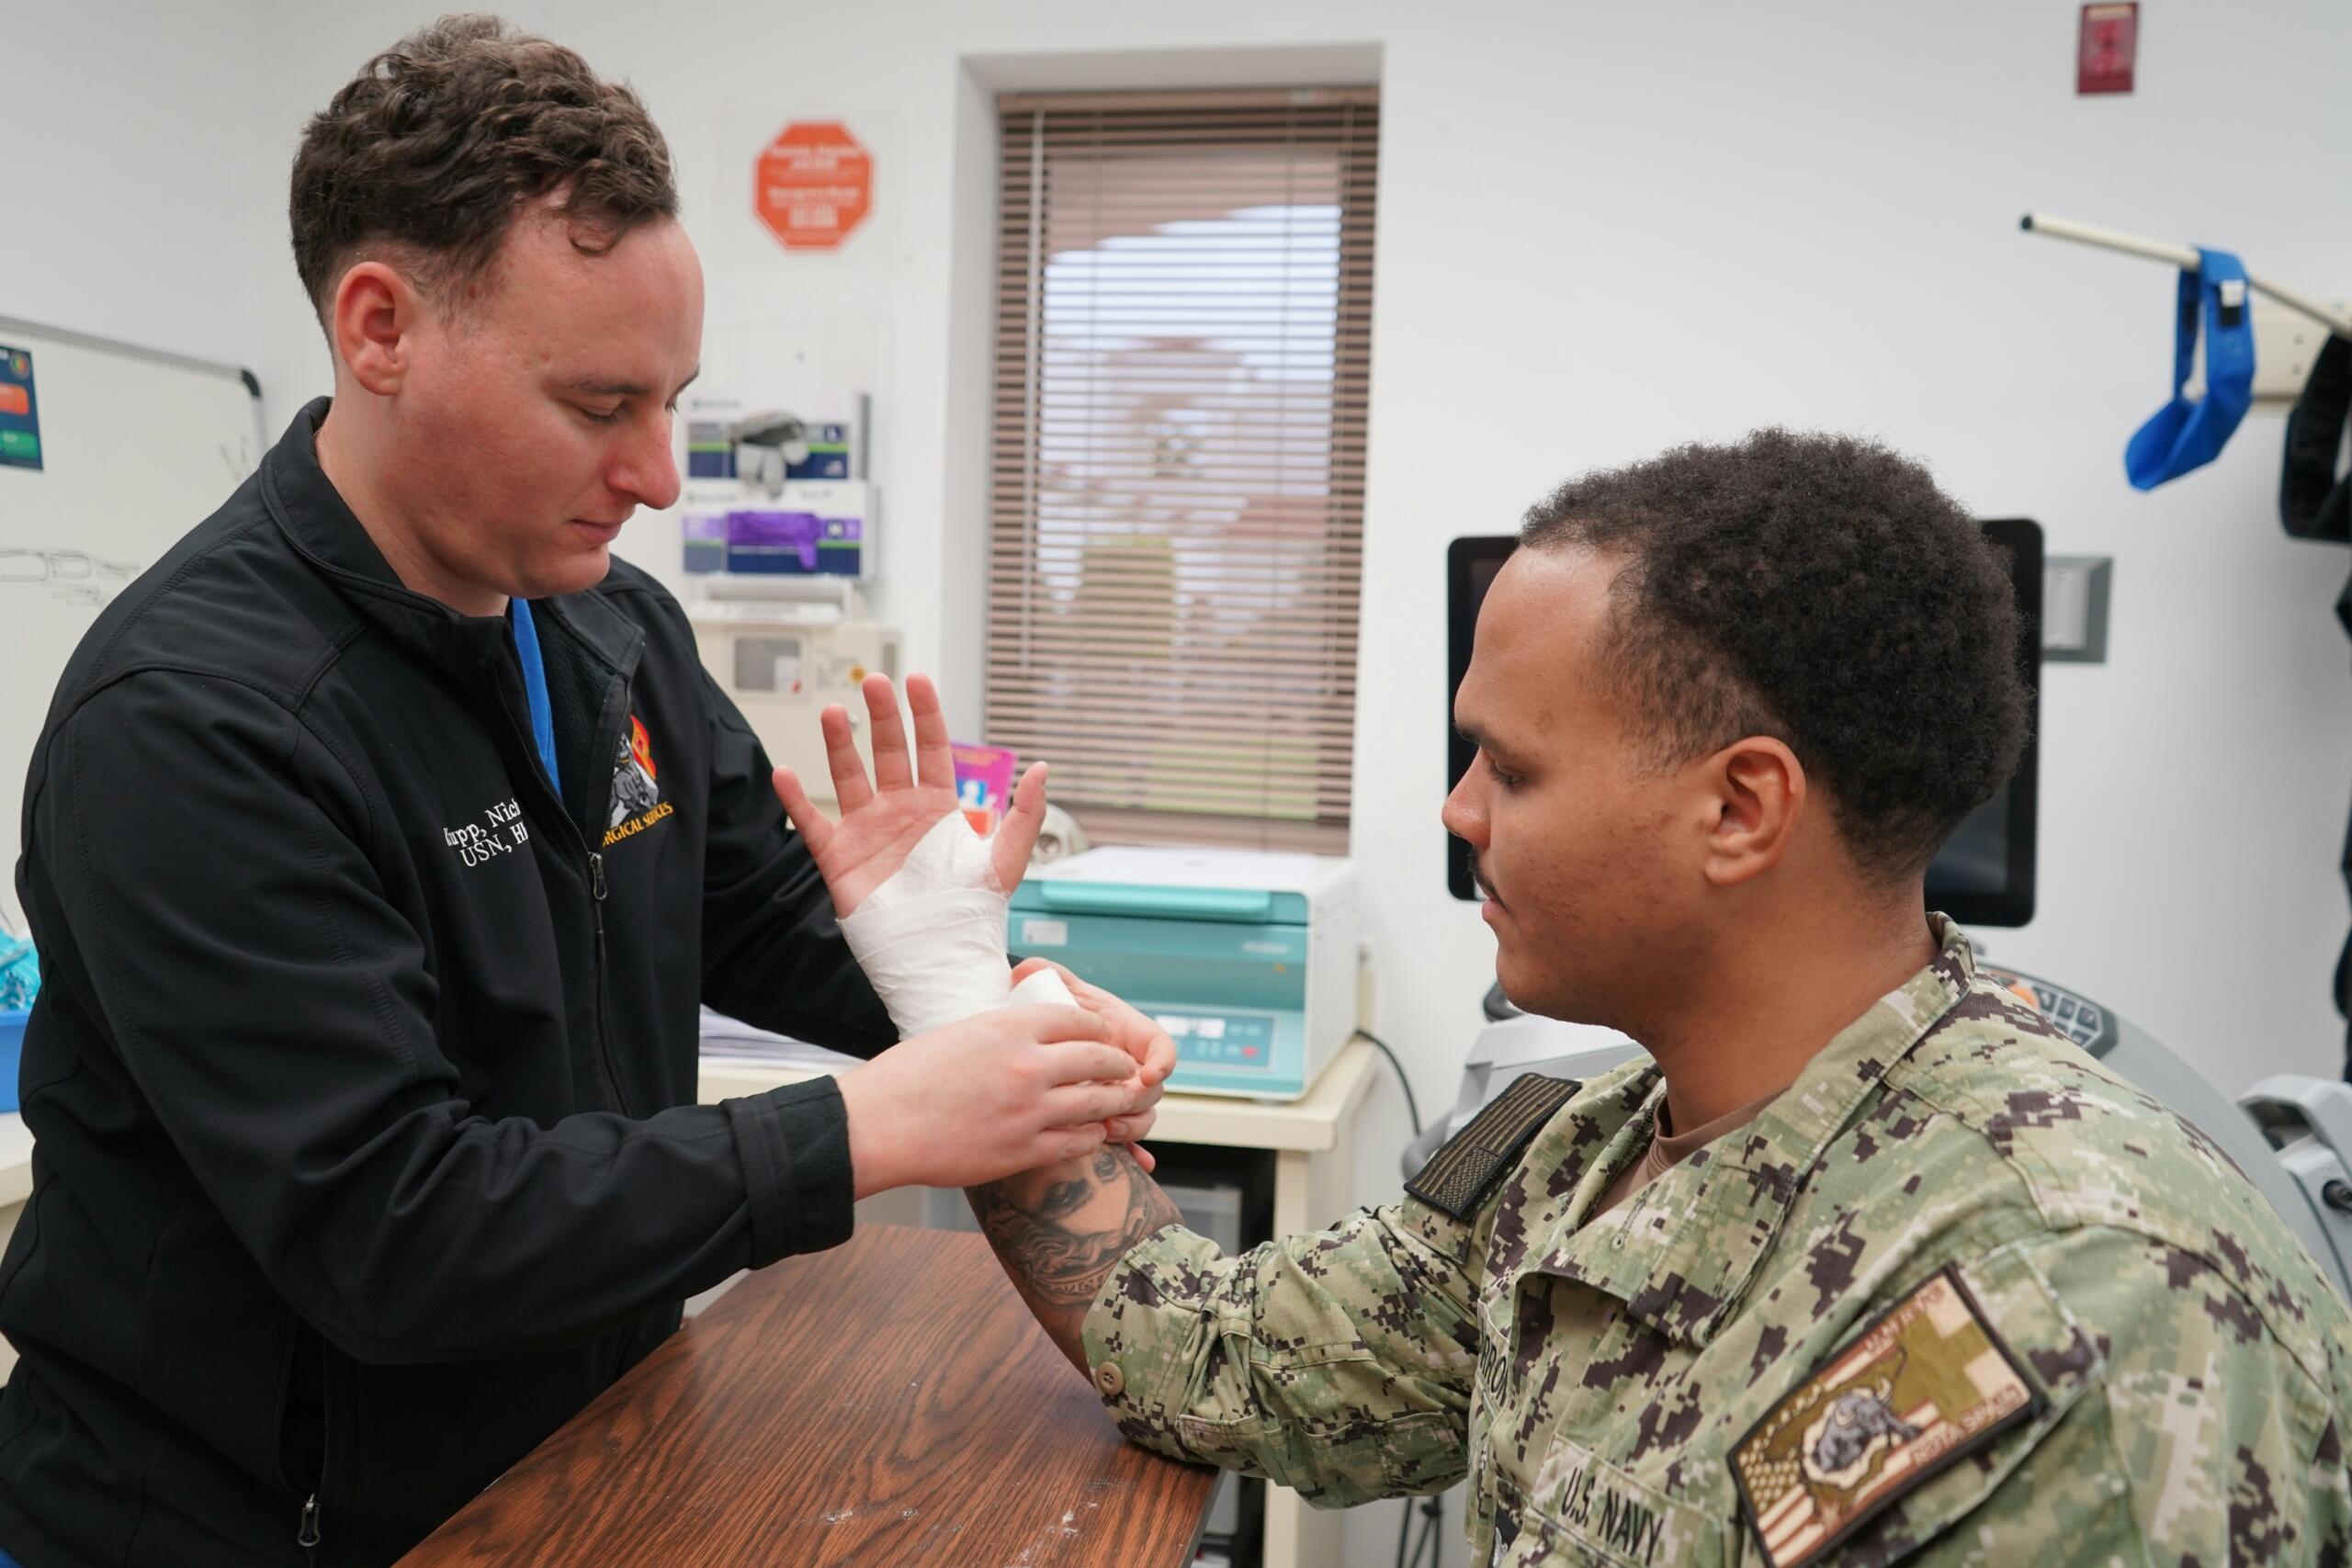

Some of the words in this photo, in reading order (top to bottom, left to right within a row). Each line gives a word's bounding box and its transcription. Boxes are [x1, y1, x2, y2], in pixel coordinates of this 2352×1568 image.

[459, 834, 512, 866] USN,
[1562, 1467, 1596, 1529] U.S.
[1598, 1486, 1665, 1567] NAVY
